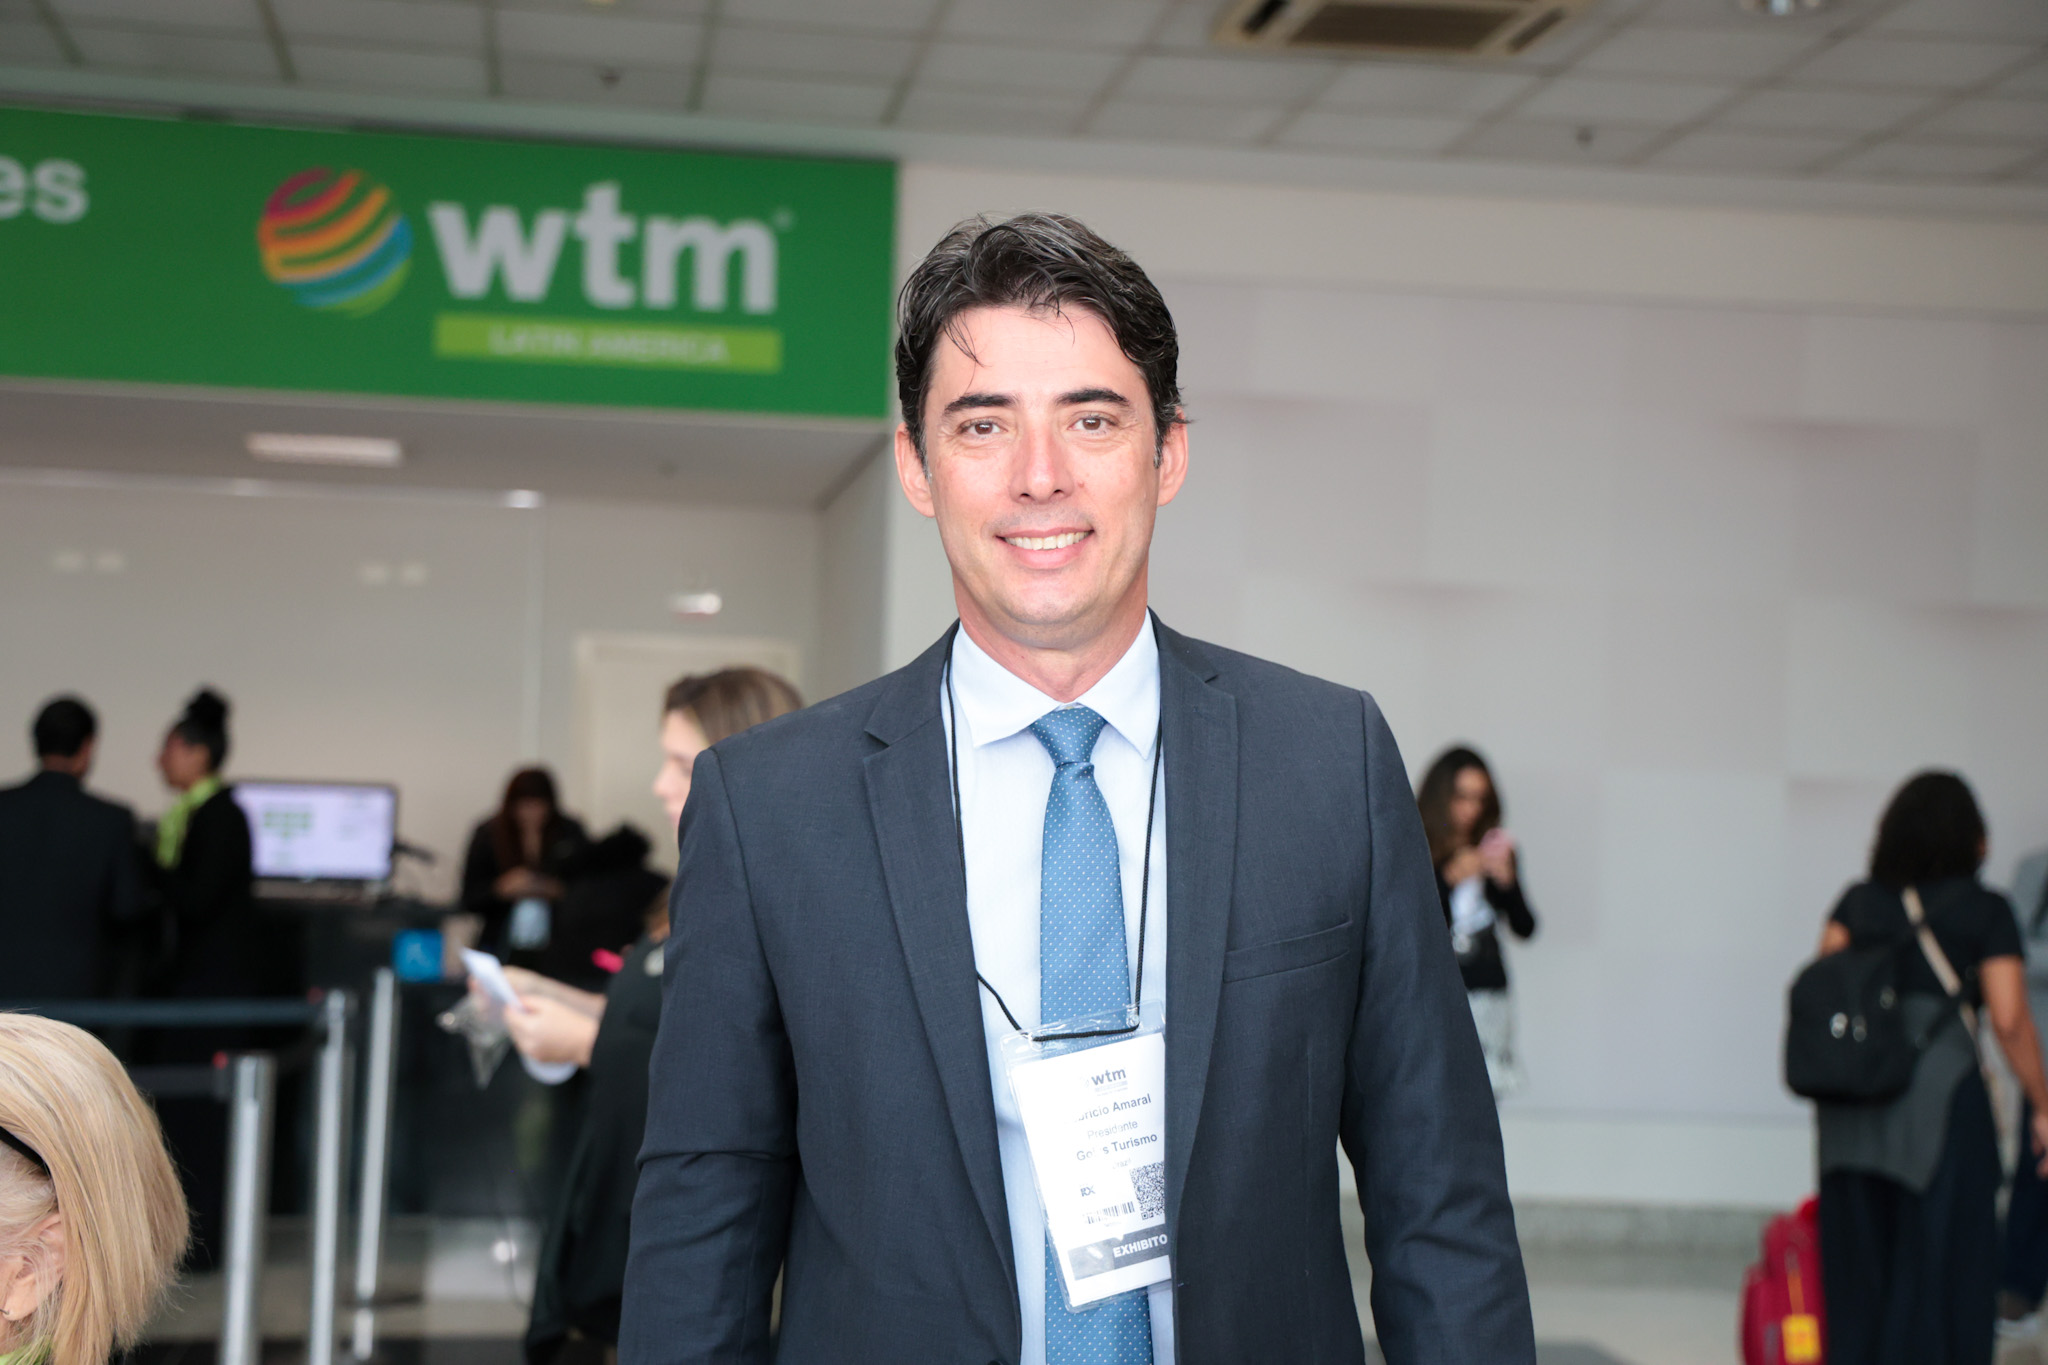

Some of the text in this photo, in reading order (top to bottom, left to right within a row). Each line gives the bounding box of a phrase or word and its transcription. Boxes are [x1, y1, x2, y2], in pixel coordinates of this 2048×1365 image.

[427, 183, 776, 313] wtm
[1091, 1068, 1126, 1086] wtm
[1112, 1092, 1152, 1112] Amaral
[1087, 1120, 1139, 1140] Presidente
[1076, 1133, 1158, 1161] Gos Turismo
[1112, 1233, 1168, 1258] EXHIBITO
